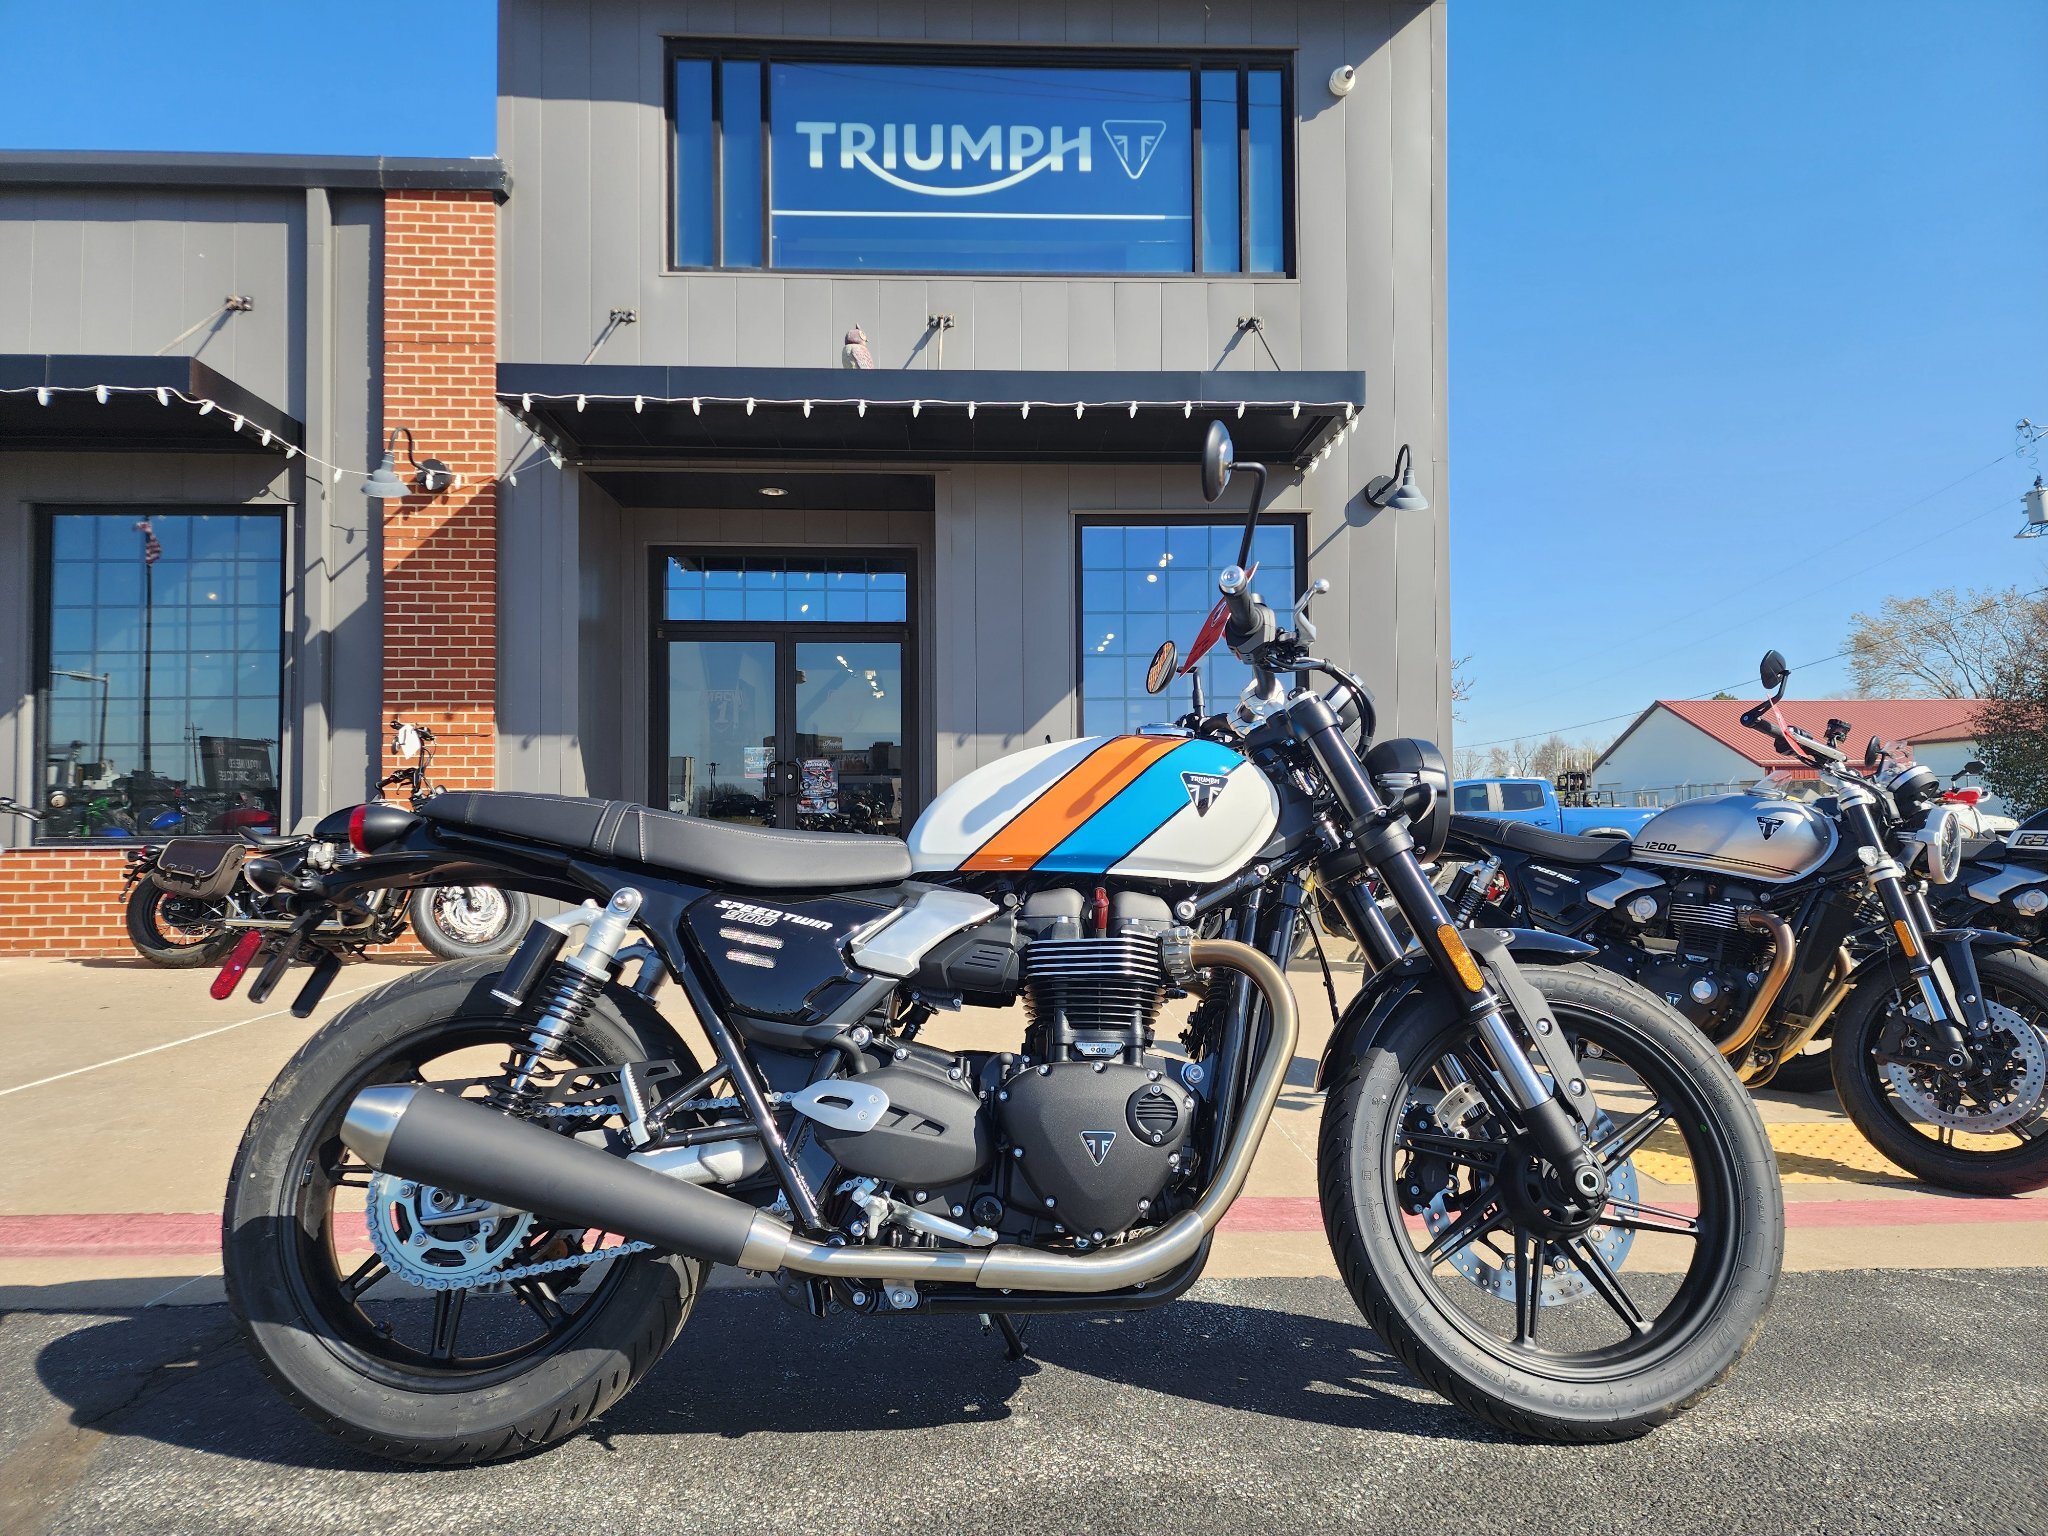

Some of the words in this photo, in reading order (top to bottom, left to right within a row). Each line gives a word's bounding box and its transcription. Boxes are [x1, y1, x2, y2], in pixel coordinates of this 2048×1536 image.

[796, 121, 1092, 196] TRIUMPH
[1190, 775, 1220, 785] TRIUMPH
[1644, 841, 1677, 852] 1200
[1528, 864, 1558, 877] SPEED
[714, 899, 783, 919] SPEED
[782, 912, 833, 931] TWIN
[720, 909, 780, 927] 900
[1564, 979, 1643, 1016] CLASSIC
